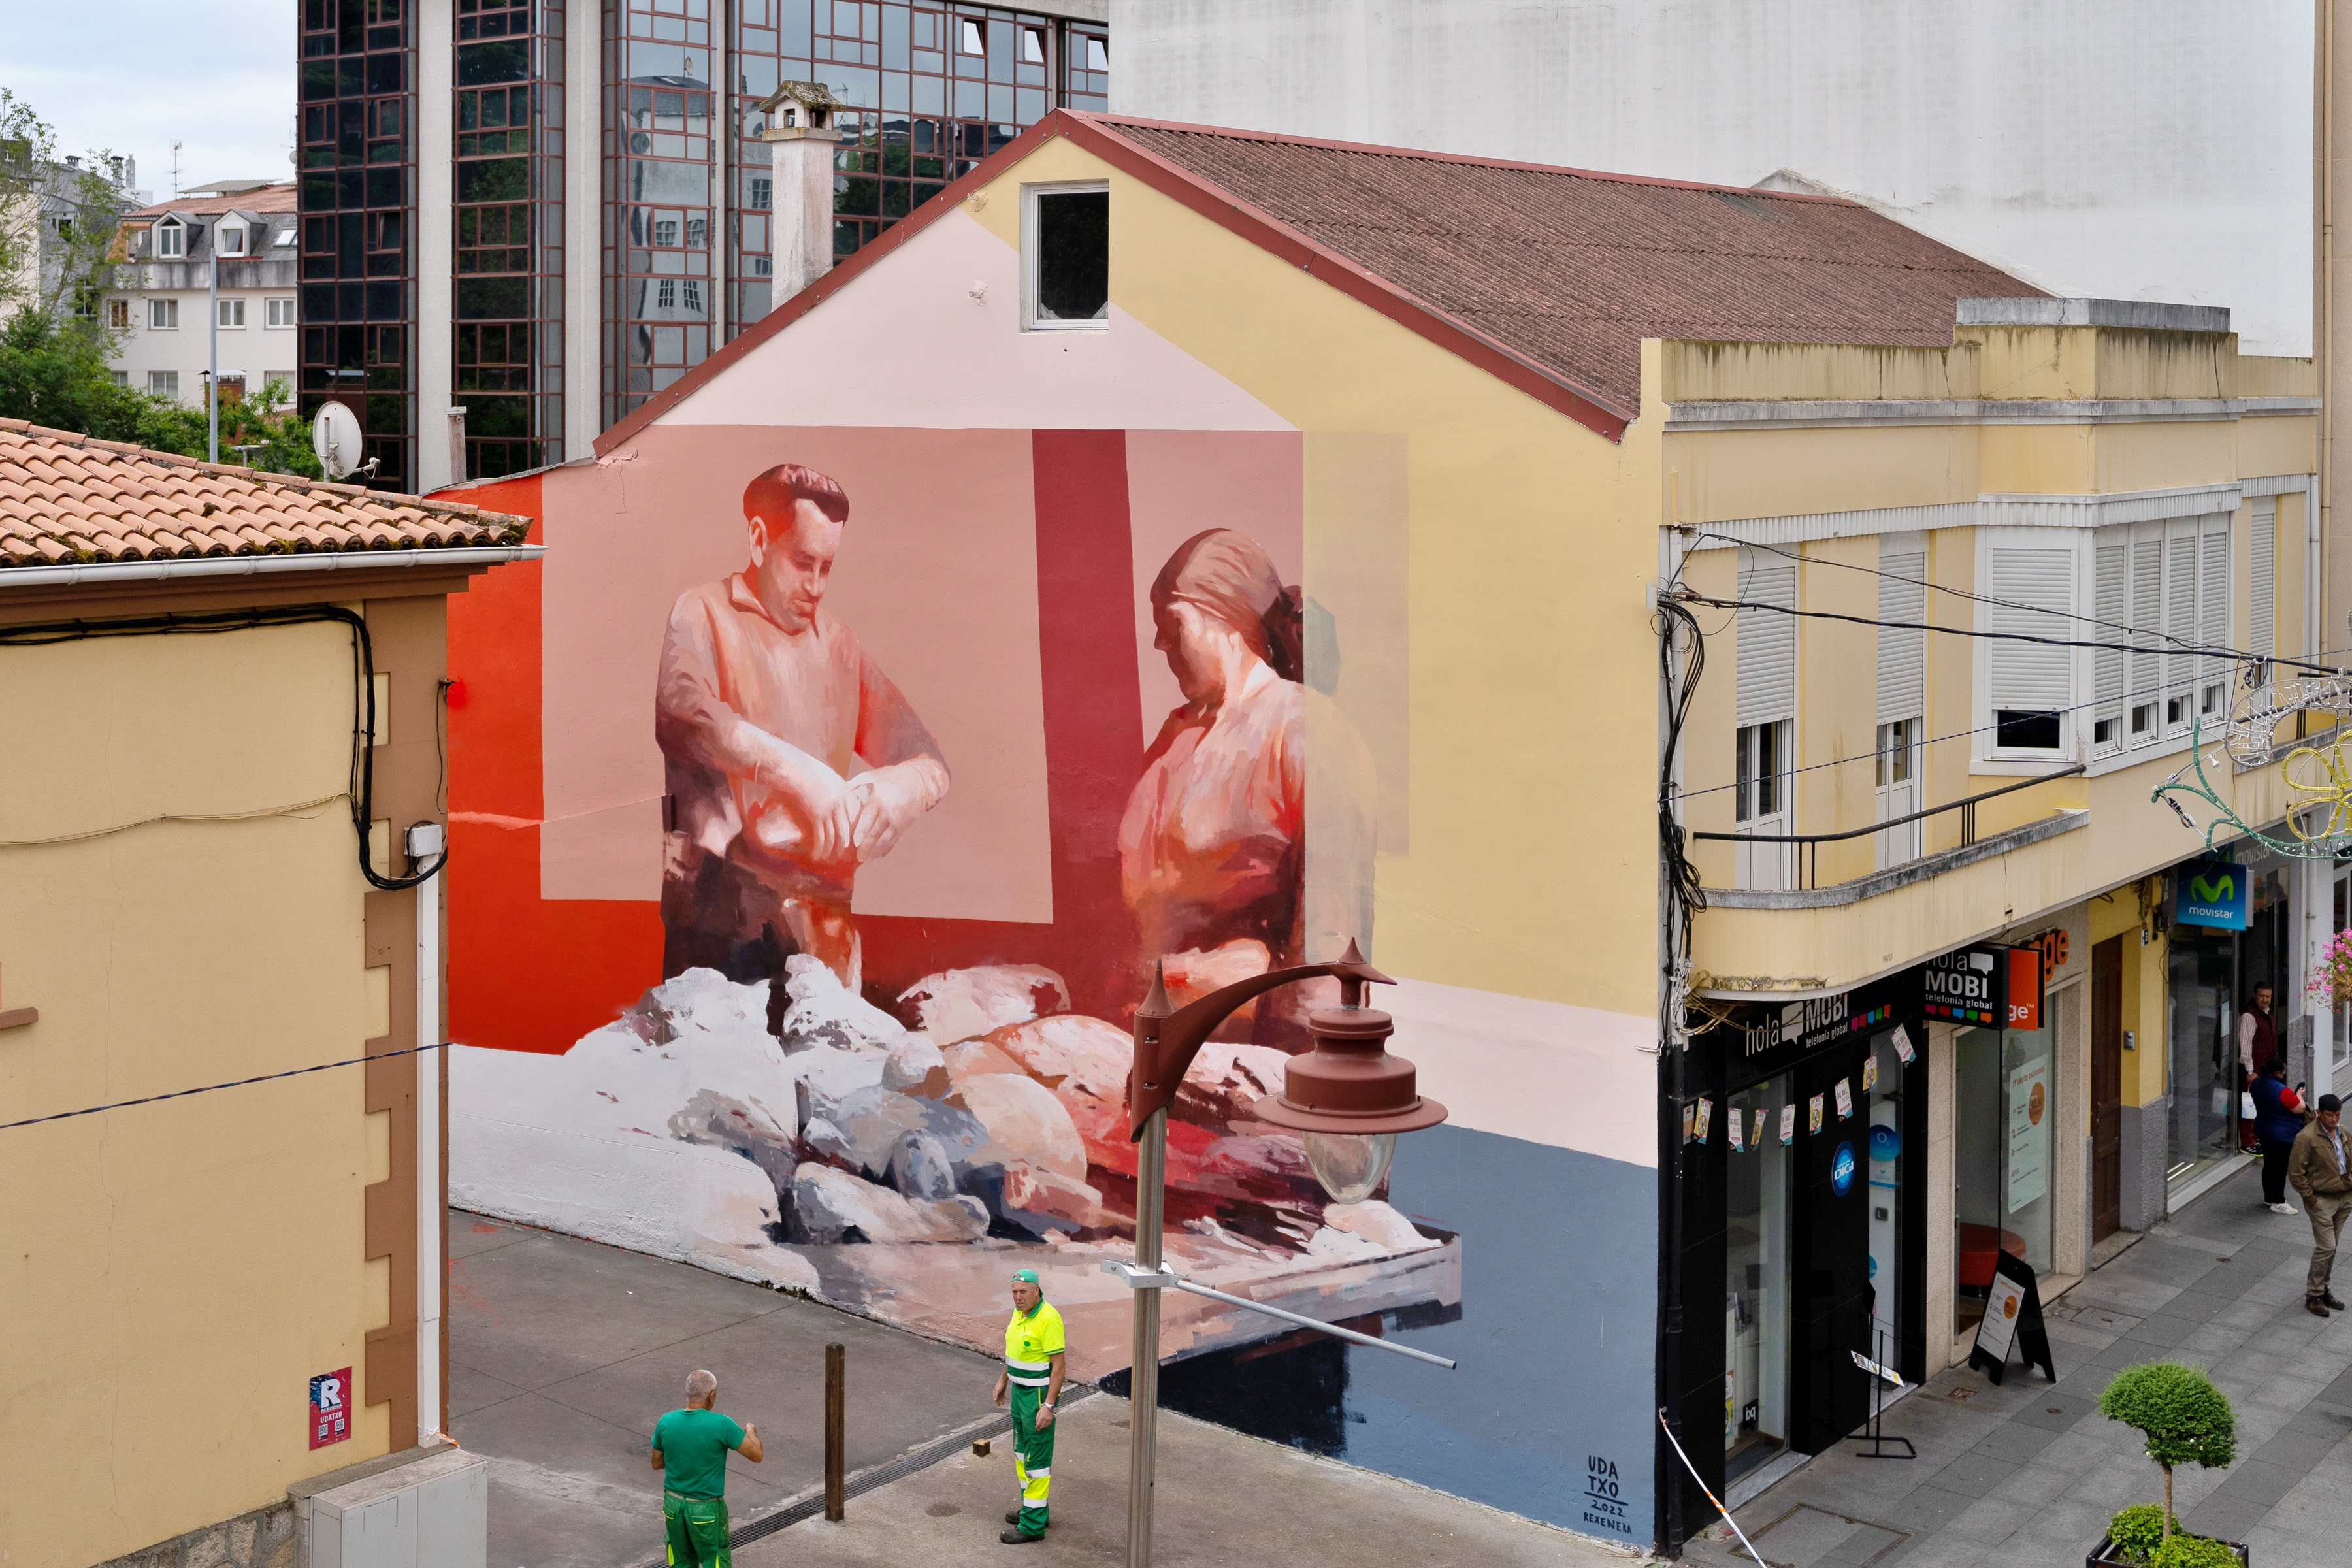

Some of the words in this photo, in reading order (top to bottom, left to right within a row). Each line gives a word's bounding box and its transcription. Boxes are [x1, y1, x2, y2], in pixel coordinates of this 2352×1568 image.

[2189, 907, 2234, 919] movistar
[1925, 970, 1987, 999] MOBI
[1925, 993, 1963, 1005] telefonía
[1966, 1000, 1992, 1010] global
[1746, 1013, 1779, 1056] hola
[1806, 992, 1848, 1033] MOBI
[1806, 1030, 1830, 1048] telefonía
[1831, 1022, 1848, 1040] global
[1834, 1160, 1854, 1181] DIGI
[321, 1378, 342, 1409] R
[320, 1411, 342, 1423] UDATXO
[1745, 1406, 1756, 1421] bq
[1588, 1455, 1618, 1480] UDA
[1588, 1475, 1619, 1498] TXO
[1590, 1499, 1625, 1518] 2022
[1584, 1512, 1632, 1535] REXENERA
